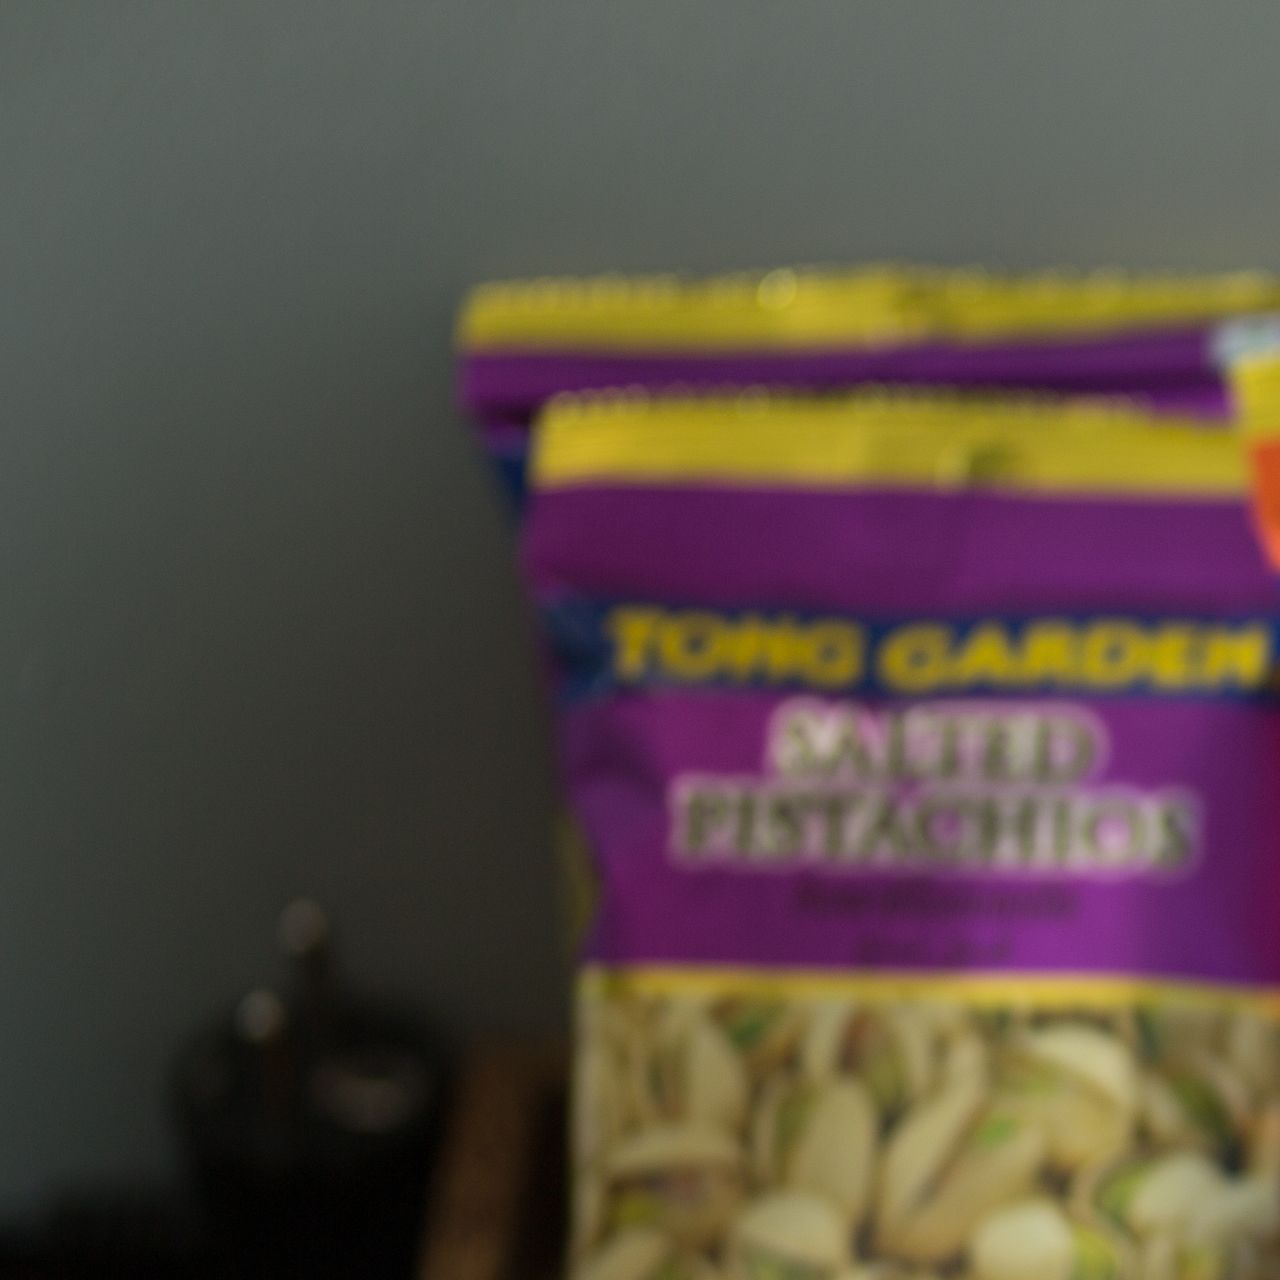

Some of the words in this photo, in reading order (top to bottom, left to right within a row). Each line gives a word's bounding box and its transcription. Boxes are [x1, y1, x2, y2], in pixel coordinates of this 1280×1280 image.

[610, 606, 868, 690] TONG
[878, 621, 1271, 692] GARDEN
[774, 706, 1100, 785] SALTED
[680, 788, 1198, 872] PISTACHIOS
